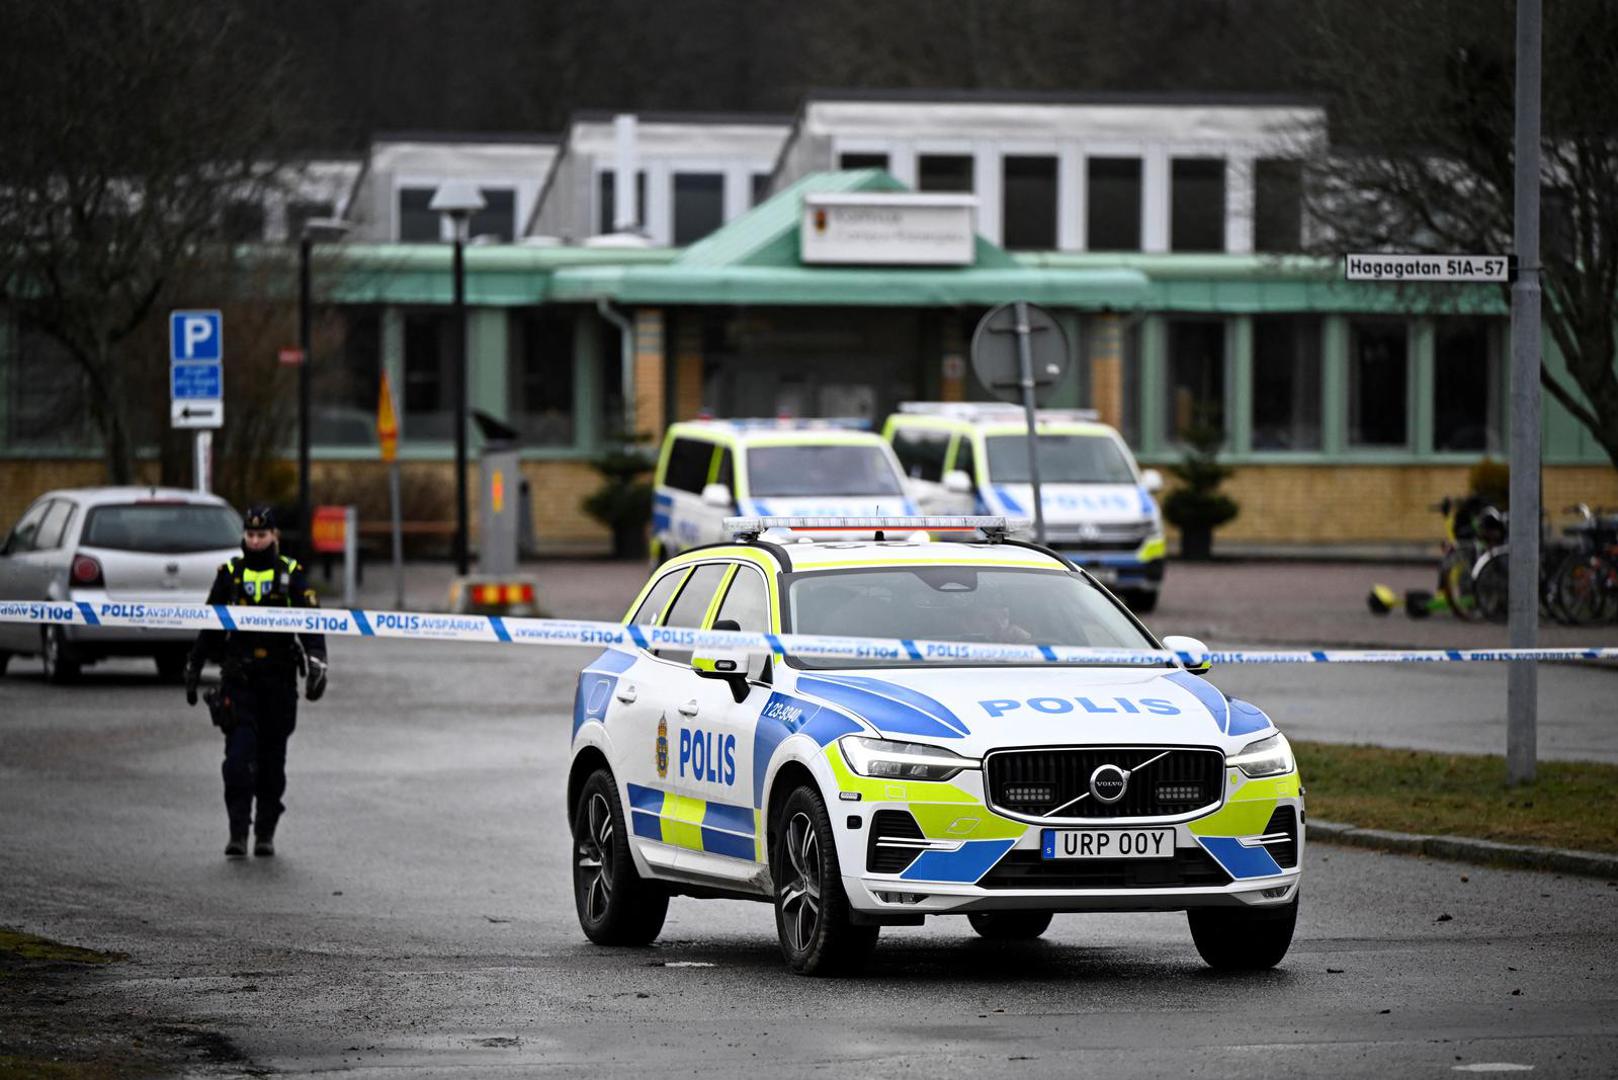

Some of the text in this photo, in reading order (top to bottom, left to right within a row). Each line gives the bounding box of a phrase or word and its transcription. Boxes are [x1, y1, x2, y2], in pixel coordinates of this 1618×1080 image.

[1350, 259, 1505, 279] Hagagatan 51A-57
[184, 317, 213, 357] P
[29, 606, 73, 620] POLIS
[101, 604, 145, 618] POLIS
[305, 616, 348, 631] POLIS
[376, 614, 419, 630] POLIS
[580, 629, 624, 644] POLIS
[652, 629, 695, 644] POLIS
[926, 644, 970, 658] POLIS
[1202, 653, 1244, 664] POLIS
[977, 696, 1182, 718] POLIS
[679, 728, 736, 786] POLIS
[1064, 833, 1110, 855] URP
